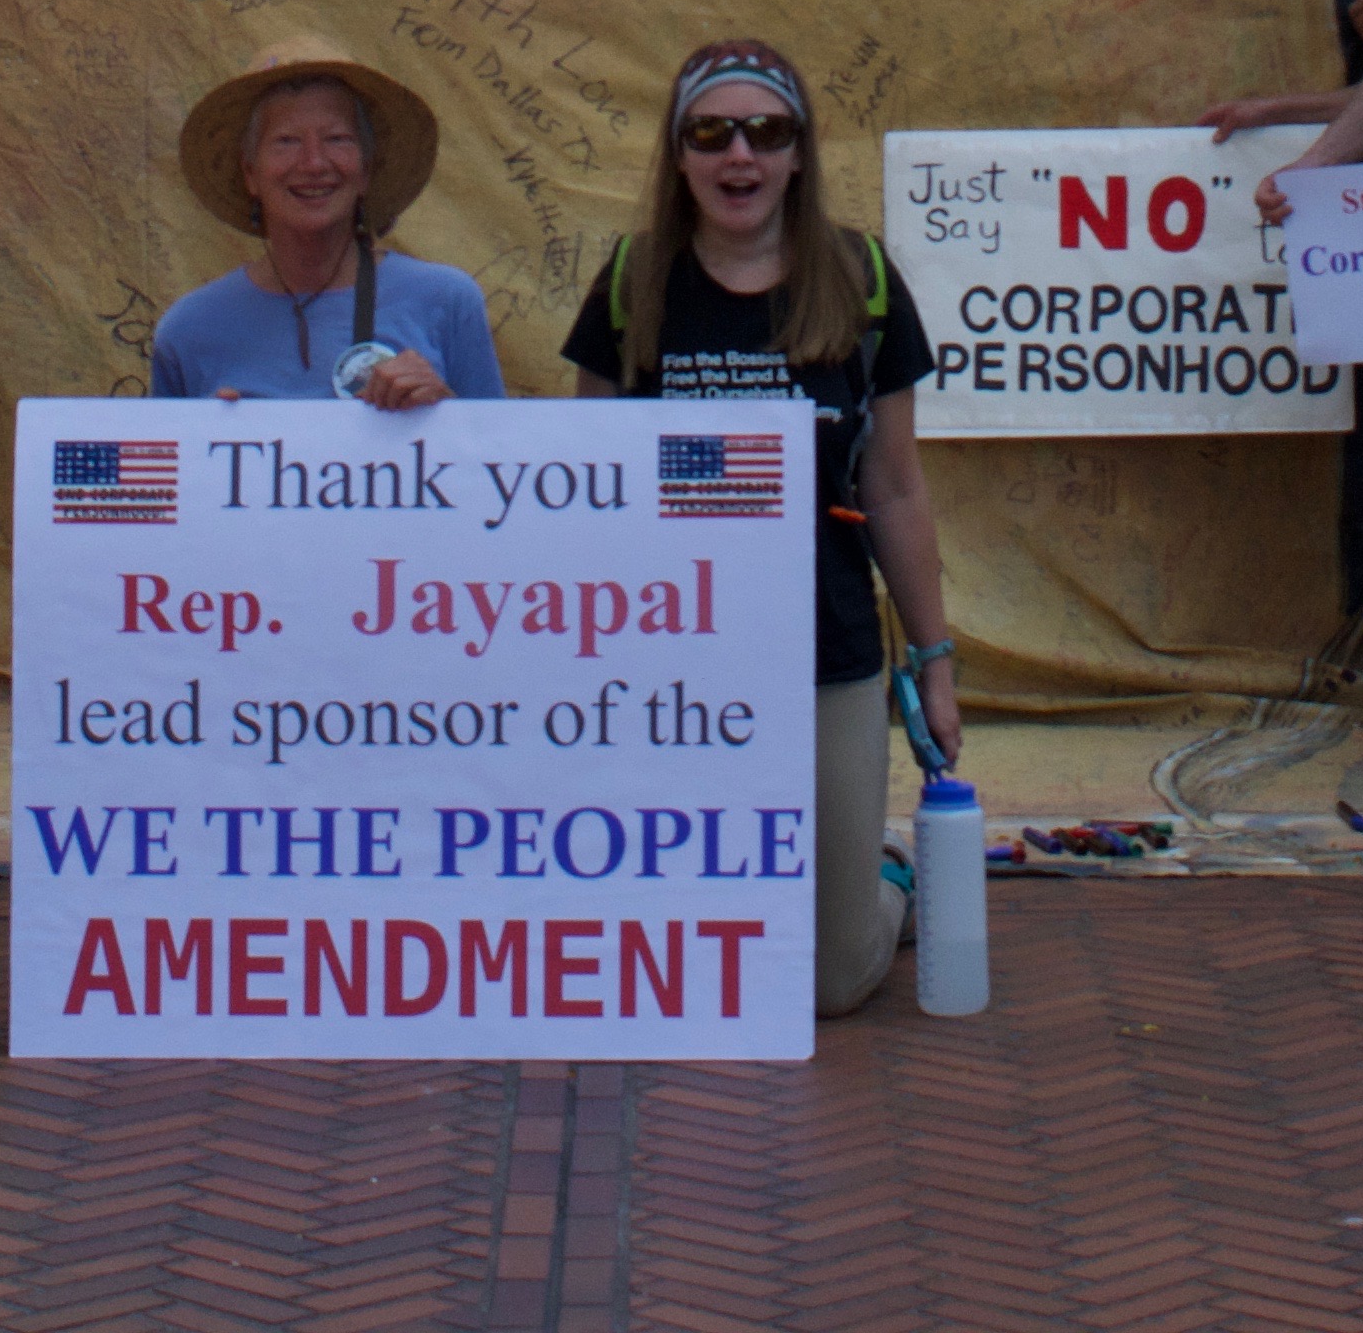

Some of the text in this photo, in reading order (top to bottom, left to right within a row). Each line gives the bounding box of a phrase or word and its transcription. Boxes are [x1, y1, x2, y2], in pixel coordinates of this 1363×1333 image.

[552, 35, 630, 138] Love
[909, 161, 1006, 205] Just
[925, 208, 1001, 255] Say
[960, 283, 1296, 334] CORPORAT
[731, 368, 774, 384] Land
[209, 439, 629, 531] Thank you
[117, 558, 719, 658] Rep. Jayapal
[54, 679, 756, 765] lead sponsor of the
[27, 805, 806, 879] WE THE PEOPLE
[63, 916, 766, 1019] AMENDMENT
